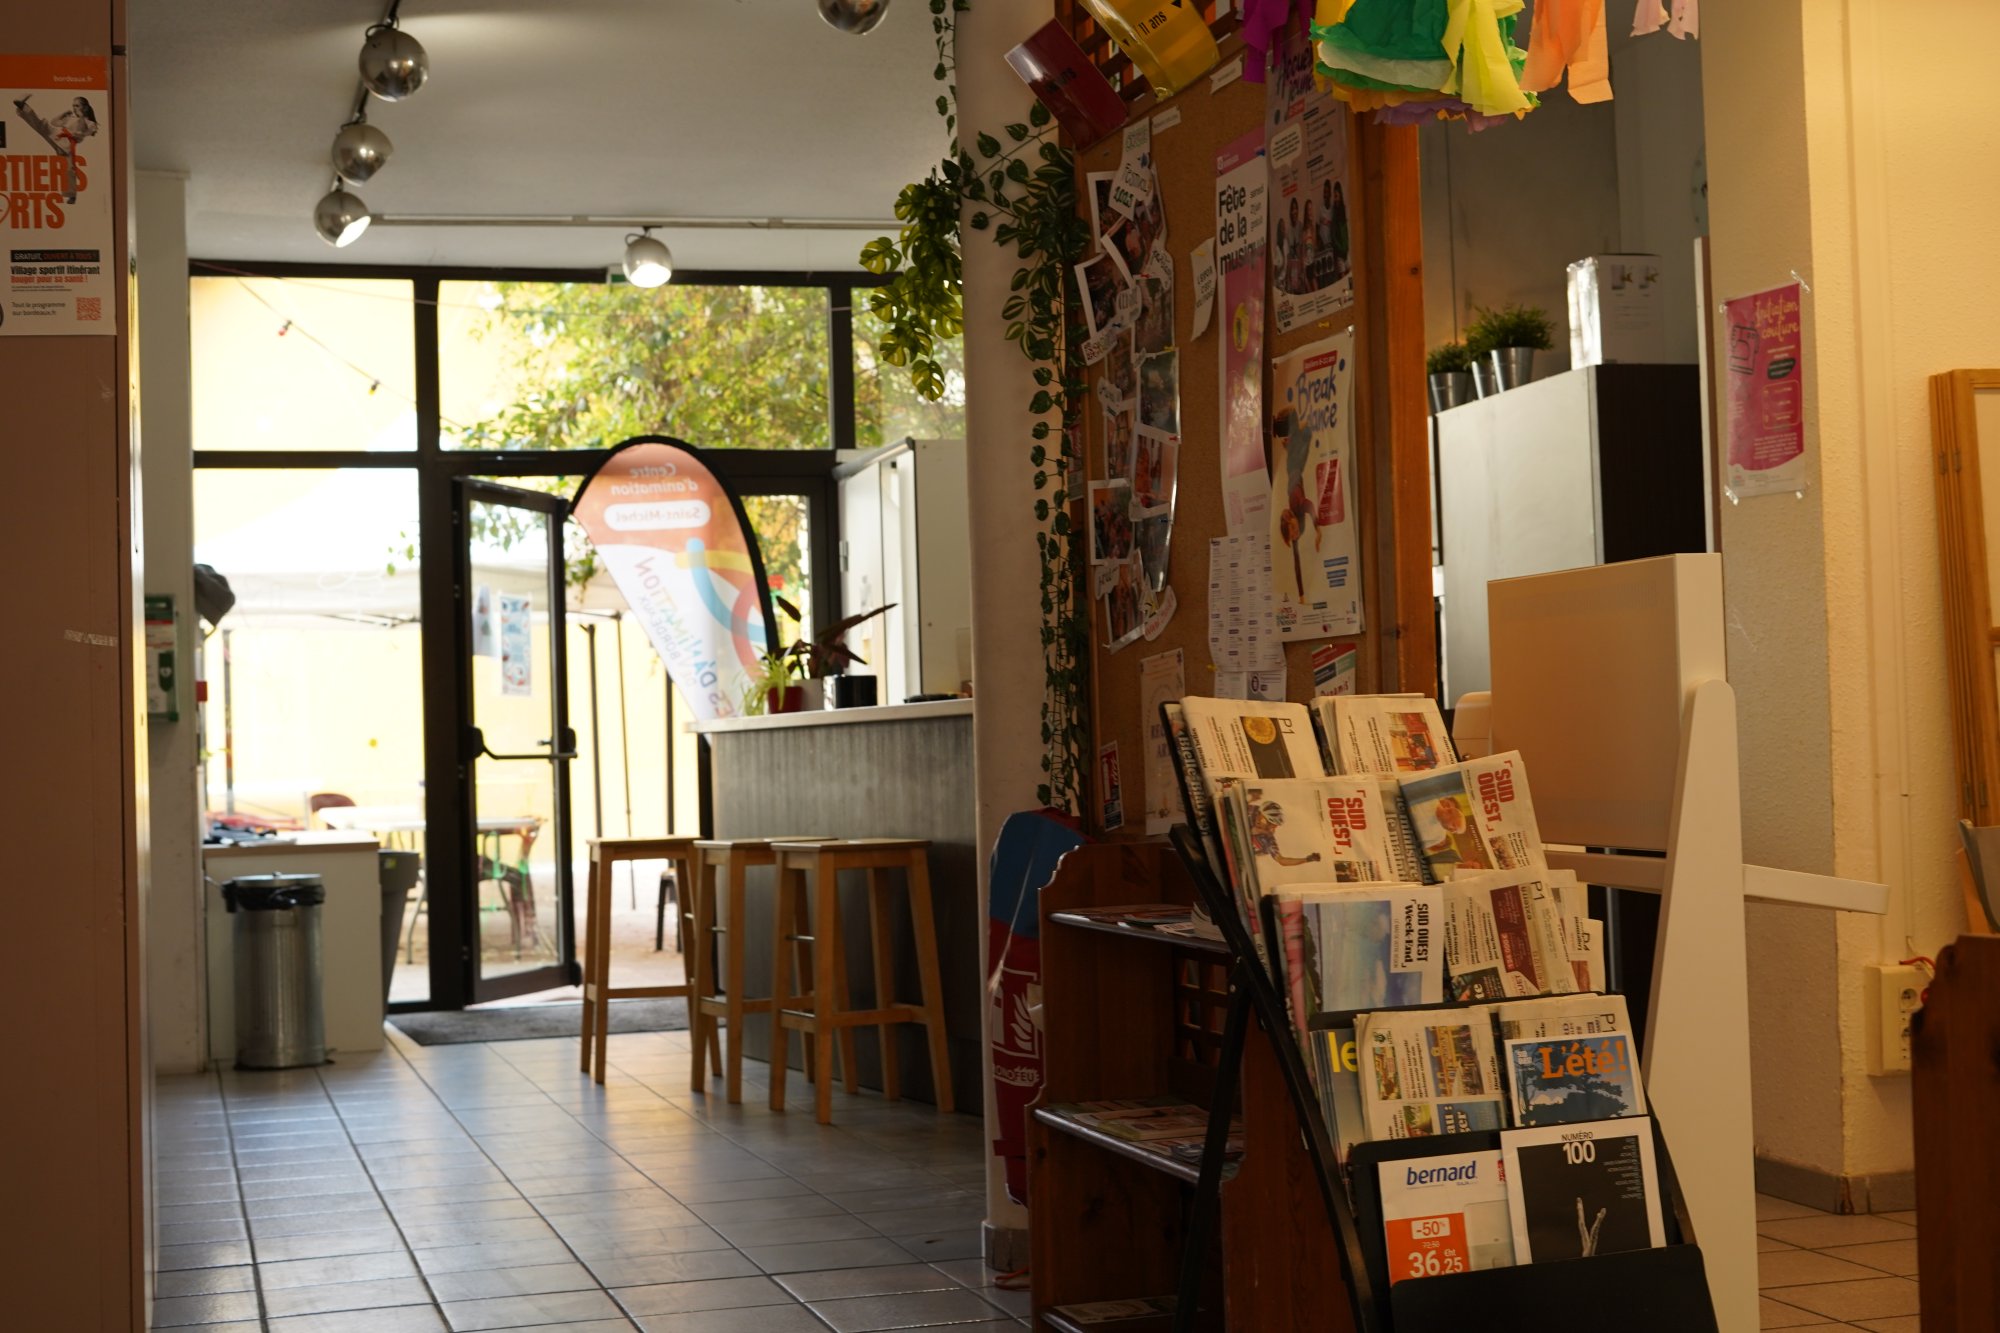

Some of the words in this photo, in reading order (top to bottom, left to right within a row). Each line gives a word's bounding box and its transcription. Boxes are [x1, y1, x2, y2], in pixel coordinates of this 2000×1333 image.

[1147, 11, 1168, 29] ans
[1218, 184, 1247, 217] Fête
[1219, 220, 1236, 246] de
[1236, 214, 1247, 240] la
[10, 266, 37, 275] Village
[39, 265, 65, 276] sportif
[66, 264, 100, 275] itinérant
[1296, 366, 1337, 420] Break
[1478, 772, 1503, 822] OUEST
[1495, 769, 1515, 803] SUD
[1328, 797, 1352, 848] OUEST
[1346, 797, 1367, 830] SUD
[1417, 902, 1430, 926] SUD
[1404, 904, 1415, 964] Week-End
[1417, 927, 1430, 962] OUEST
[1327, 1031, 1359, 1073] le
[1561, 1130, 1594, 1142] NUMÉRO
[1562, 1141, 1597, 1165] 100
[1406, 1160, 1477, 1187] bernard
[1416, 1220, 1447, 1237] -50%
